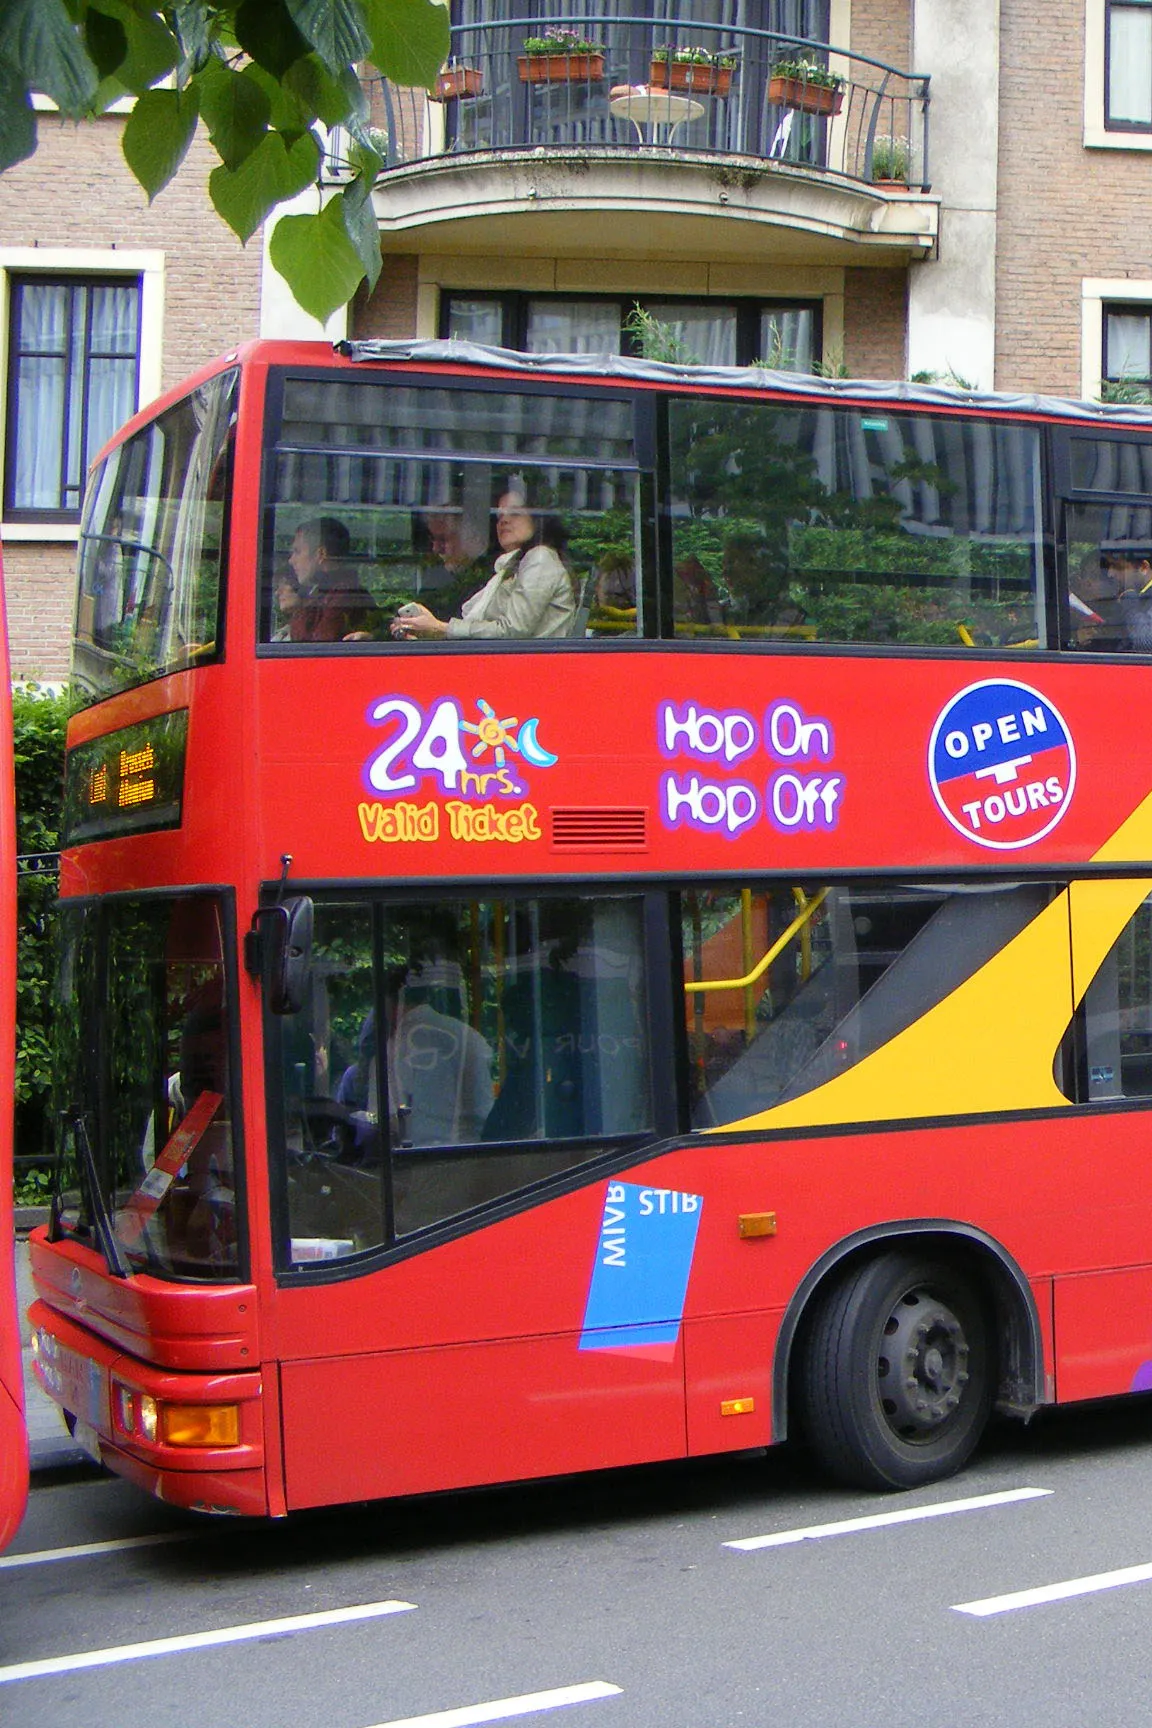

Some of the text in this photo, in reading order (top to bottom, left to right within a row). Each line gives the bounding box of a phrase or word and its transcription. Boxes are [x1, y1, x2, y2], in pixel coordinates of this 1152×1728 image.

[368, 698, 468, 791] 24
[664, 704, 830, 761] Hop On
[944, 706, 1048, 759] OPEN
[358, 800, 542, 843] Valid Ticket
[666, 773, 842, 832] Hop Off
[961, 776, 1064, 829] TOURS
[602, 1184, 626, 1267] MIVB
[638, 1188, 698, 1216] STIB
